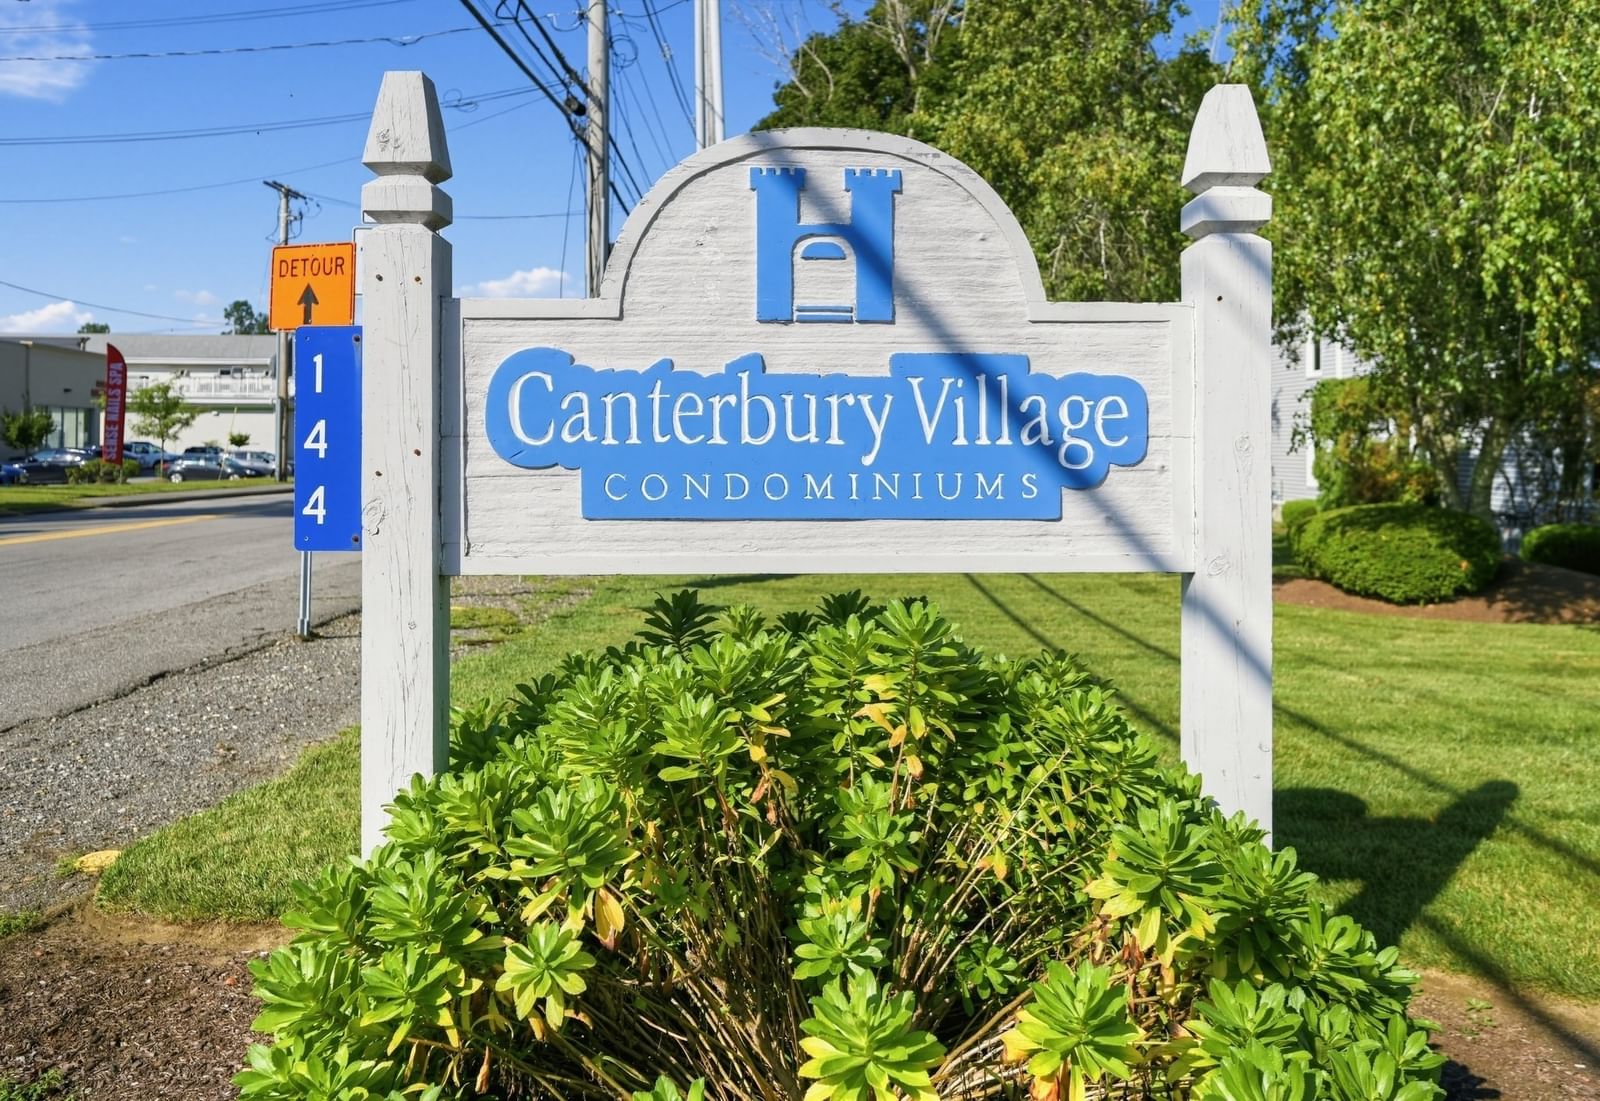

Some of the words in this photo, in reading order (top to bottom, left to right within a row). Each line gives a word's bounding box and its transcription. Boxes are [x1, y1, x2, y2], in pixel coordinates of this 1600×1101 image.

[279, 256, 345, 278] DETOUR
[109, 362, 123, 385] SPA
[107, 388, 121, 421] NAILS
[507, 369, 894, 467] Canterbury
[907, 373, 1130, 470] Village
[604, 472, 1039, 501] CONDOMINIUMS
